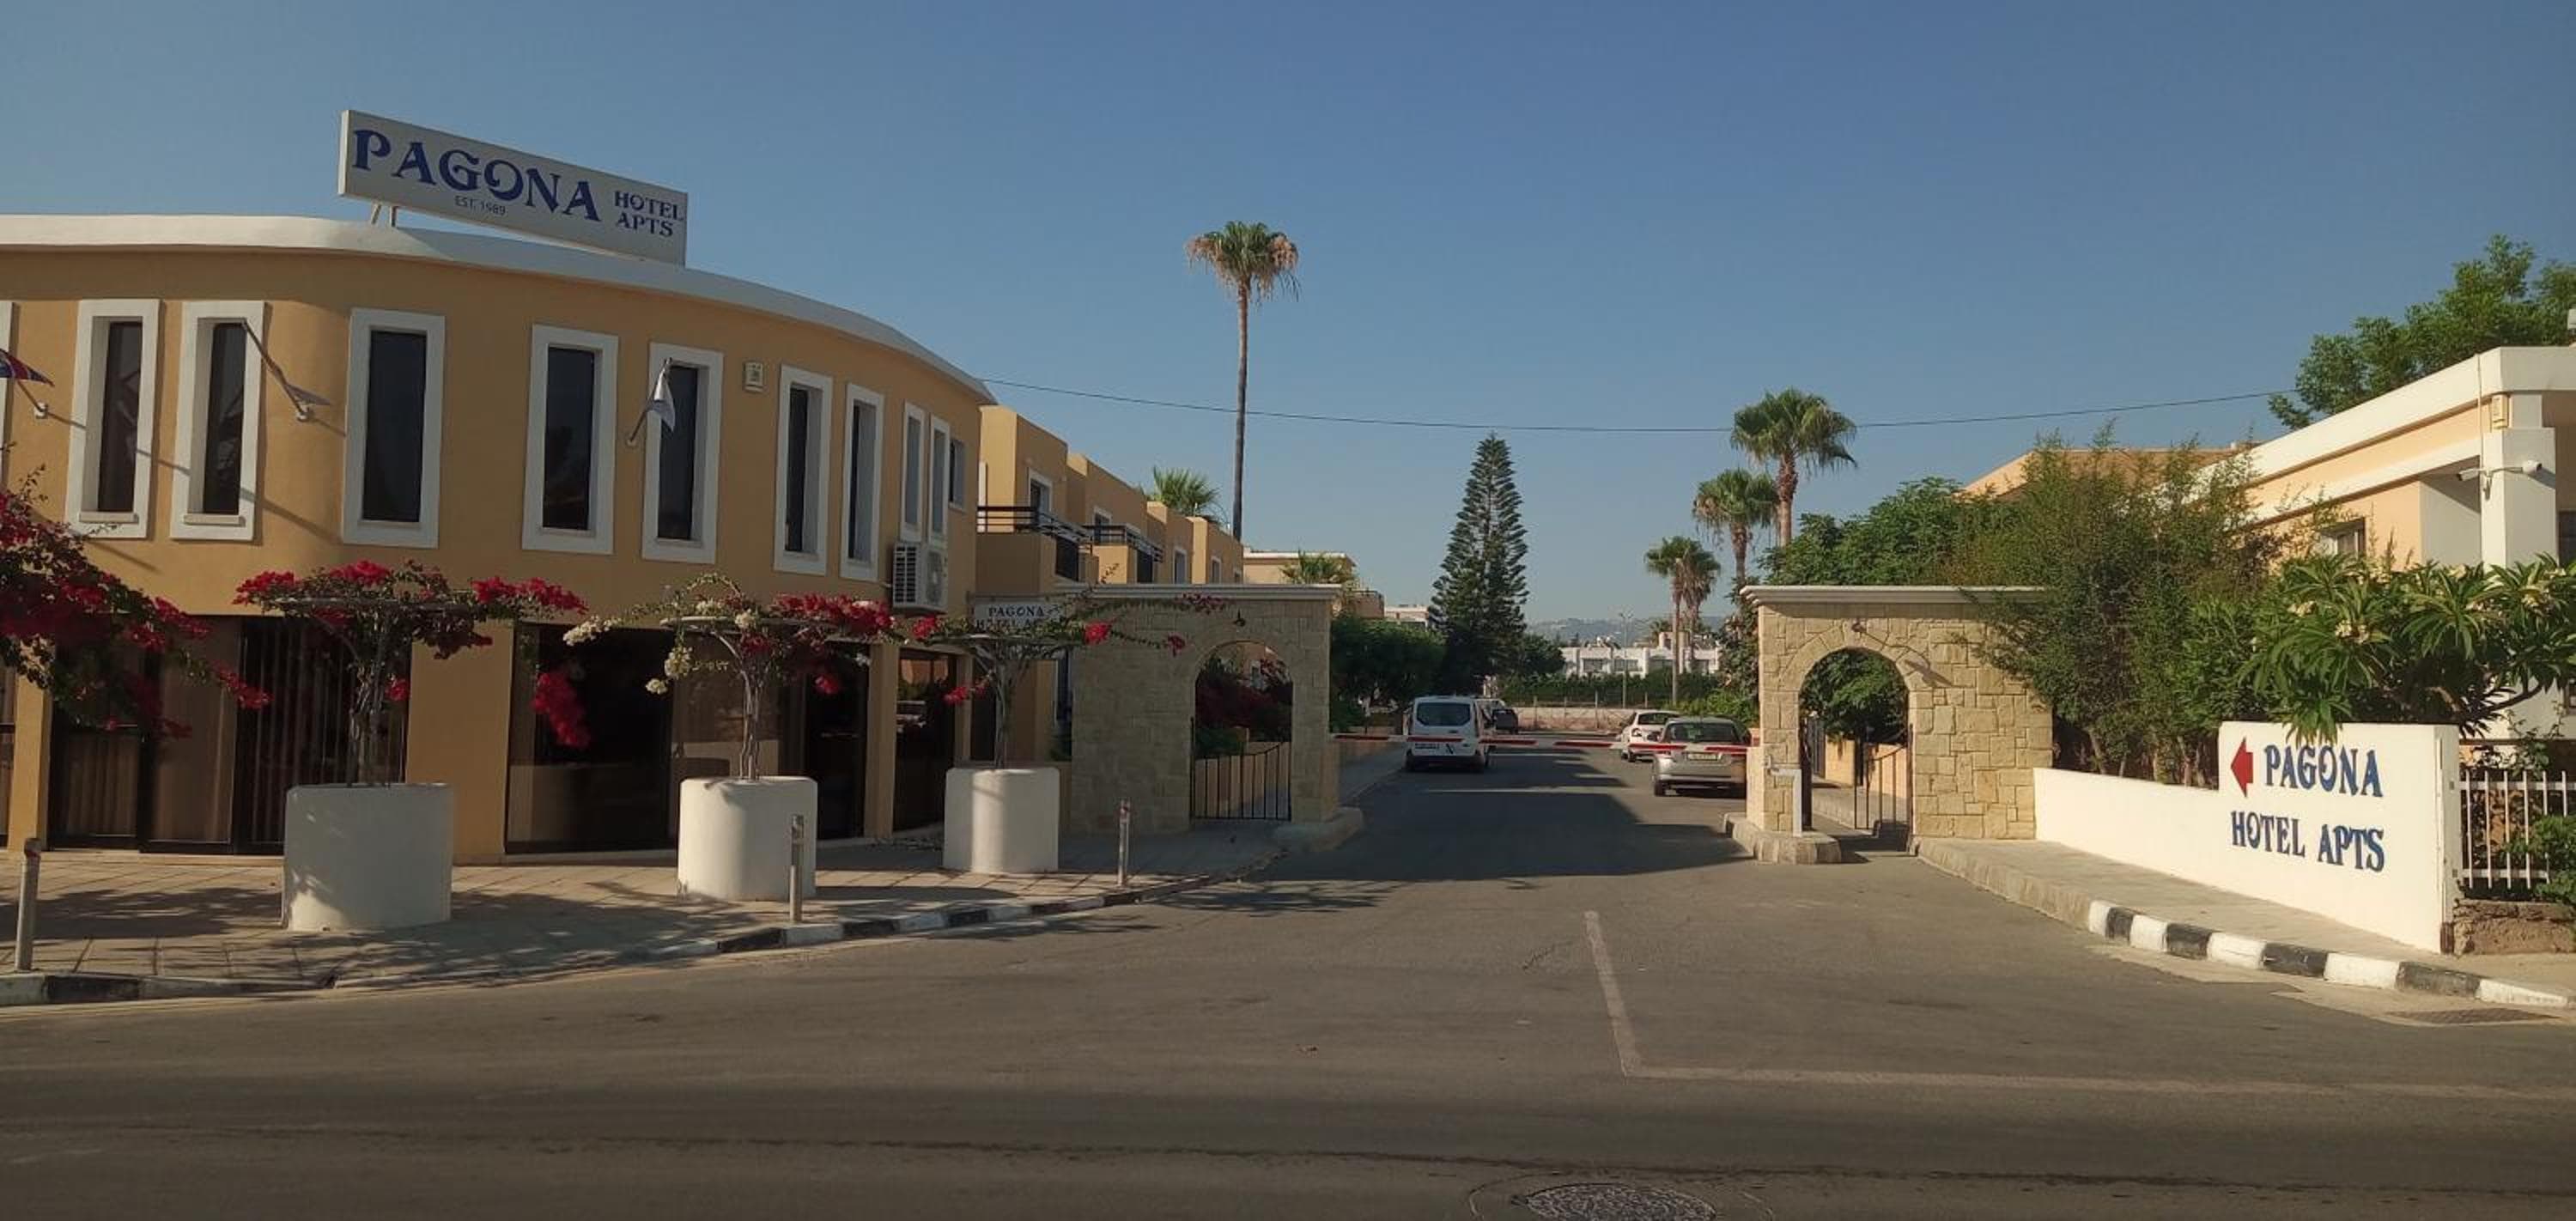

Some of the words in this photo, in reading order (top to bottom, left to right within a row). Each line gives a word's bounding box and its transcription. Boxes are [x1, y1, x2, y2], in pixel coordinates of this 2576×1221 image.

[353, 130, 601, 222] PAGONA
[615, 190, 685, 222] HOTEL
[616, 212, 674, 238] APTS
[988, 605, 1045, 617] PAGONA
[2263, 744, 2384, 798] PAGONA
[2230, 810, 2306, 858] HOTEL
[2317, 823, 2386, 873] APTS
